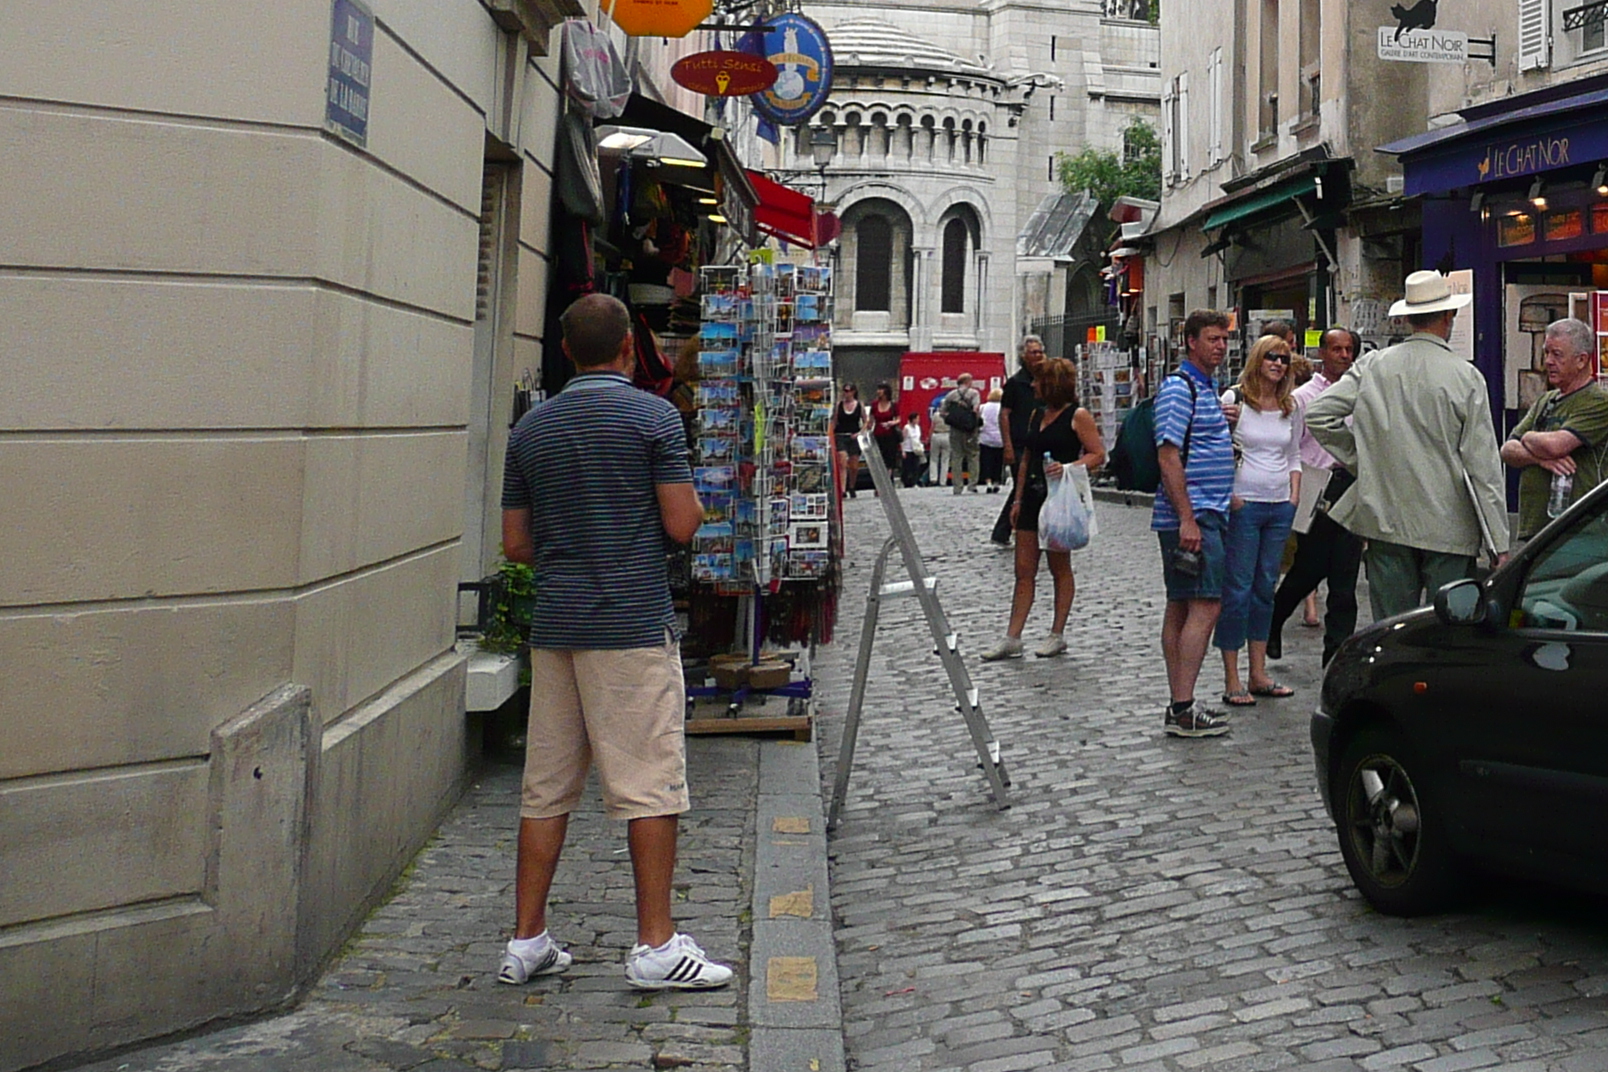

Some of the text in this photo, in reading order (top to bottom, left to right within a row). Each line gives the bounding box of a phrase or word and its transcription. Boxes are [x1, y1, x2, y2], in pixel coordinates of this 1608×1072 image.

[1380, 31, 1393, 48] LE
[1398, 33, 1430, 49] CHAT
[1494, 149, 1504, 178] LE
[1506, 145, 1537, 174] CHAT
